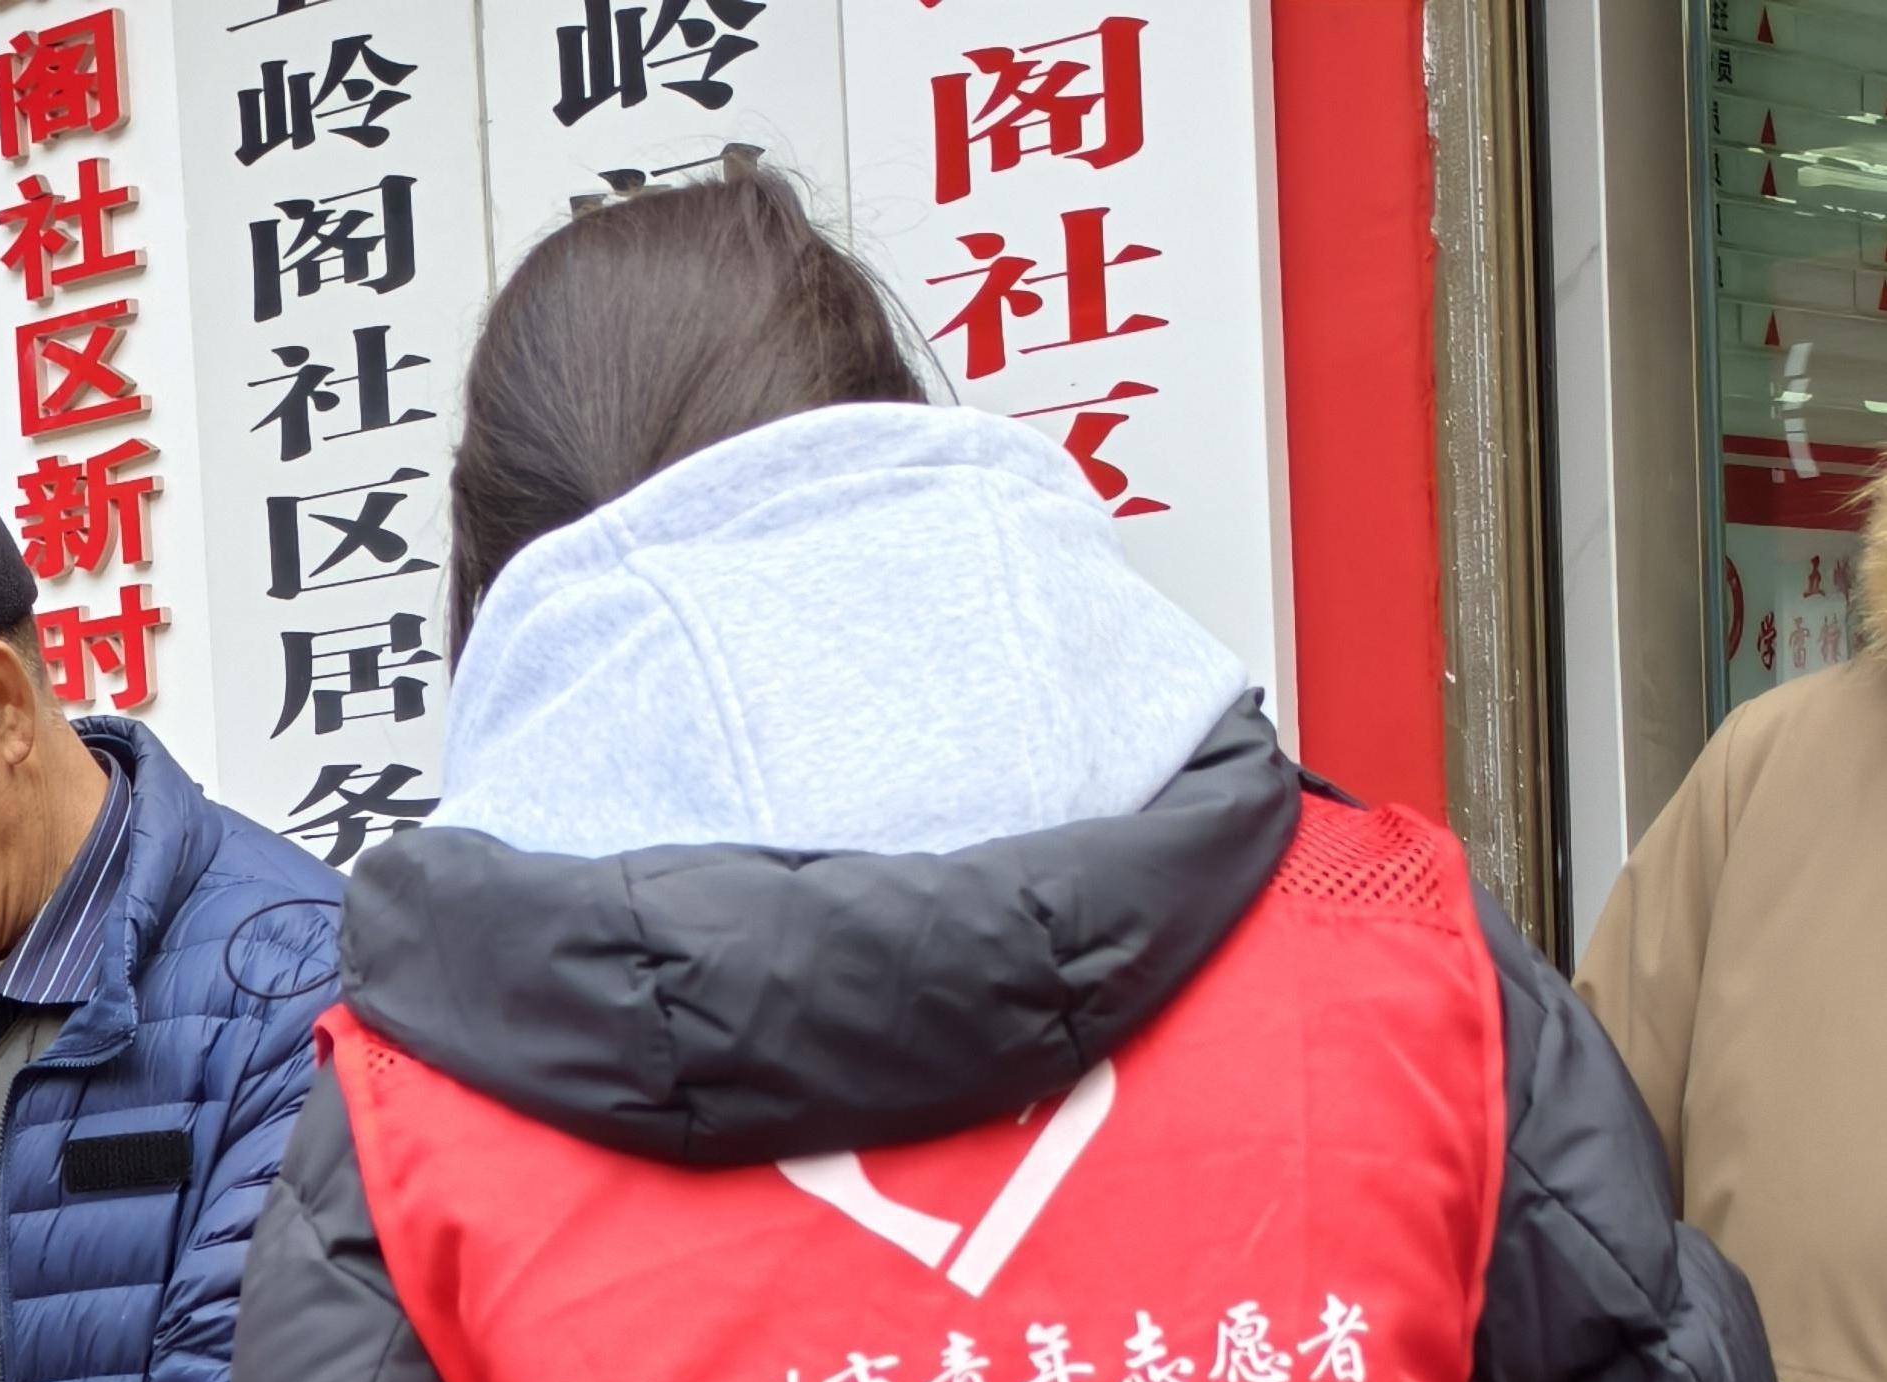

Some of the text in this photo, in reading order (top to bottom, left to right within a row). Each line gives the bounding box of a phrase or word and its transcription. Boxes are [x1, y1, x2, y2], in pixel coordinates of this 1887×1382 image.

[553, 0, 766, 205] 岭
[921, 0, 1171, 518] 阁社
[224, 0, 442, 868] 岭阁社区居务
